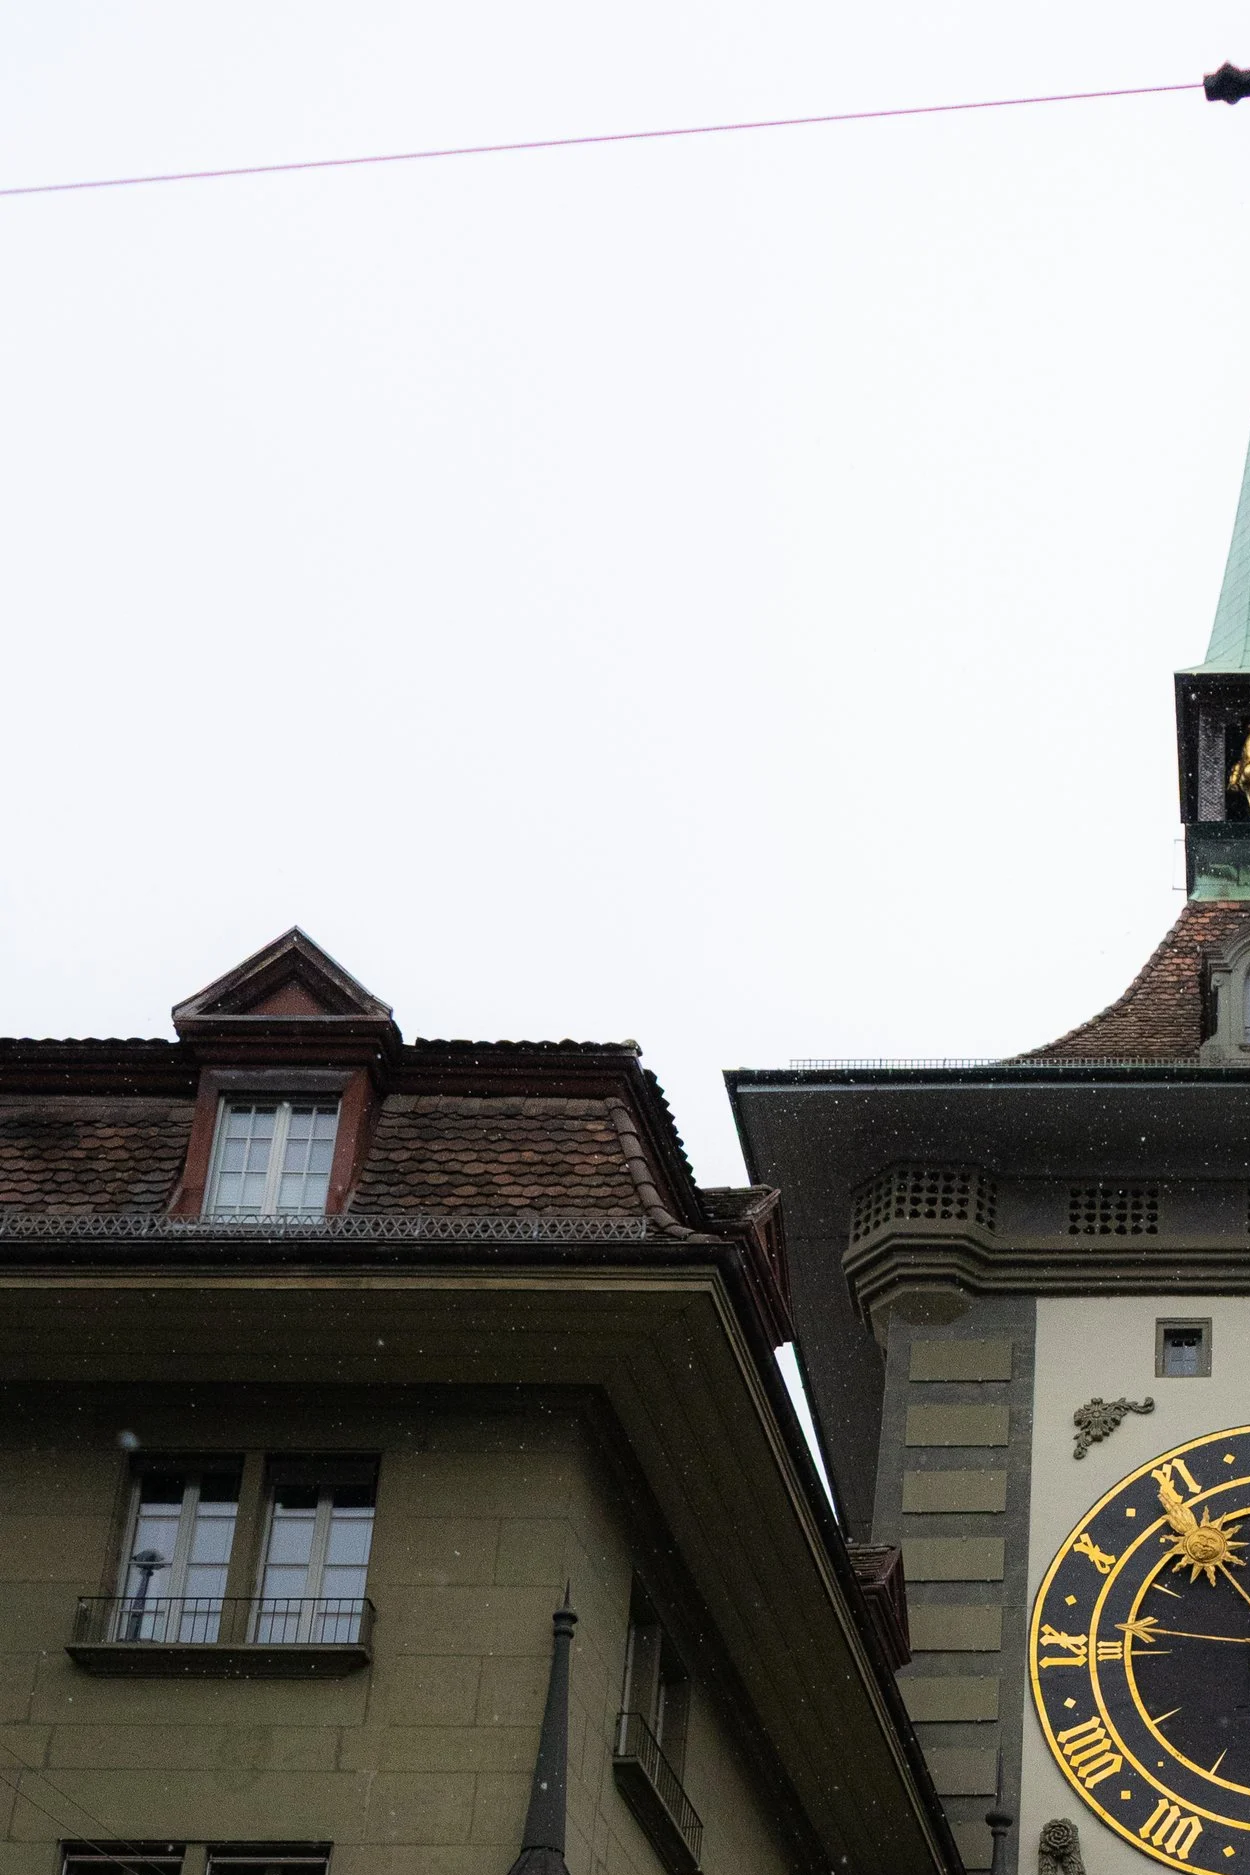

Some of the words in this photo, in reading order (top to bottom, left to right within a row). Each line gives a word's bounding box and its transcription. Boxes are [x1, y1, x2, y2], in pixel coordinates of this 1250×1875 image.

[1151, 1458, 1201, 1502] XI
[1074, 1533, 1115, 1574] X
[1040, 1624, 1088, 1669] IX
[1097, 1640, 1122, 1661] III
[1057, 1716, 1122, 1789] VIII
[1139, 1798, 1203, 1859] VII
